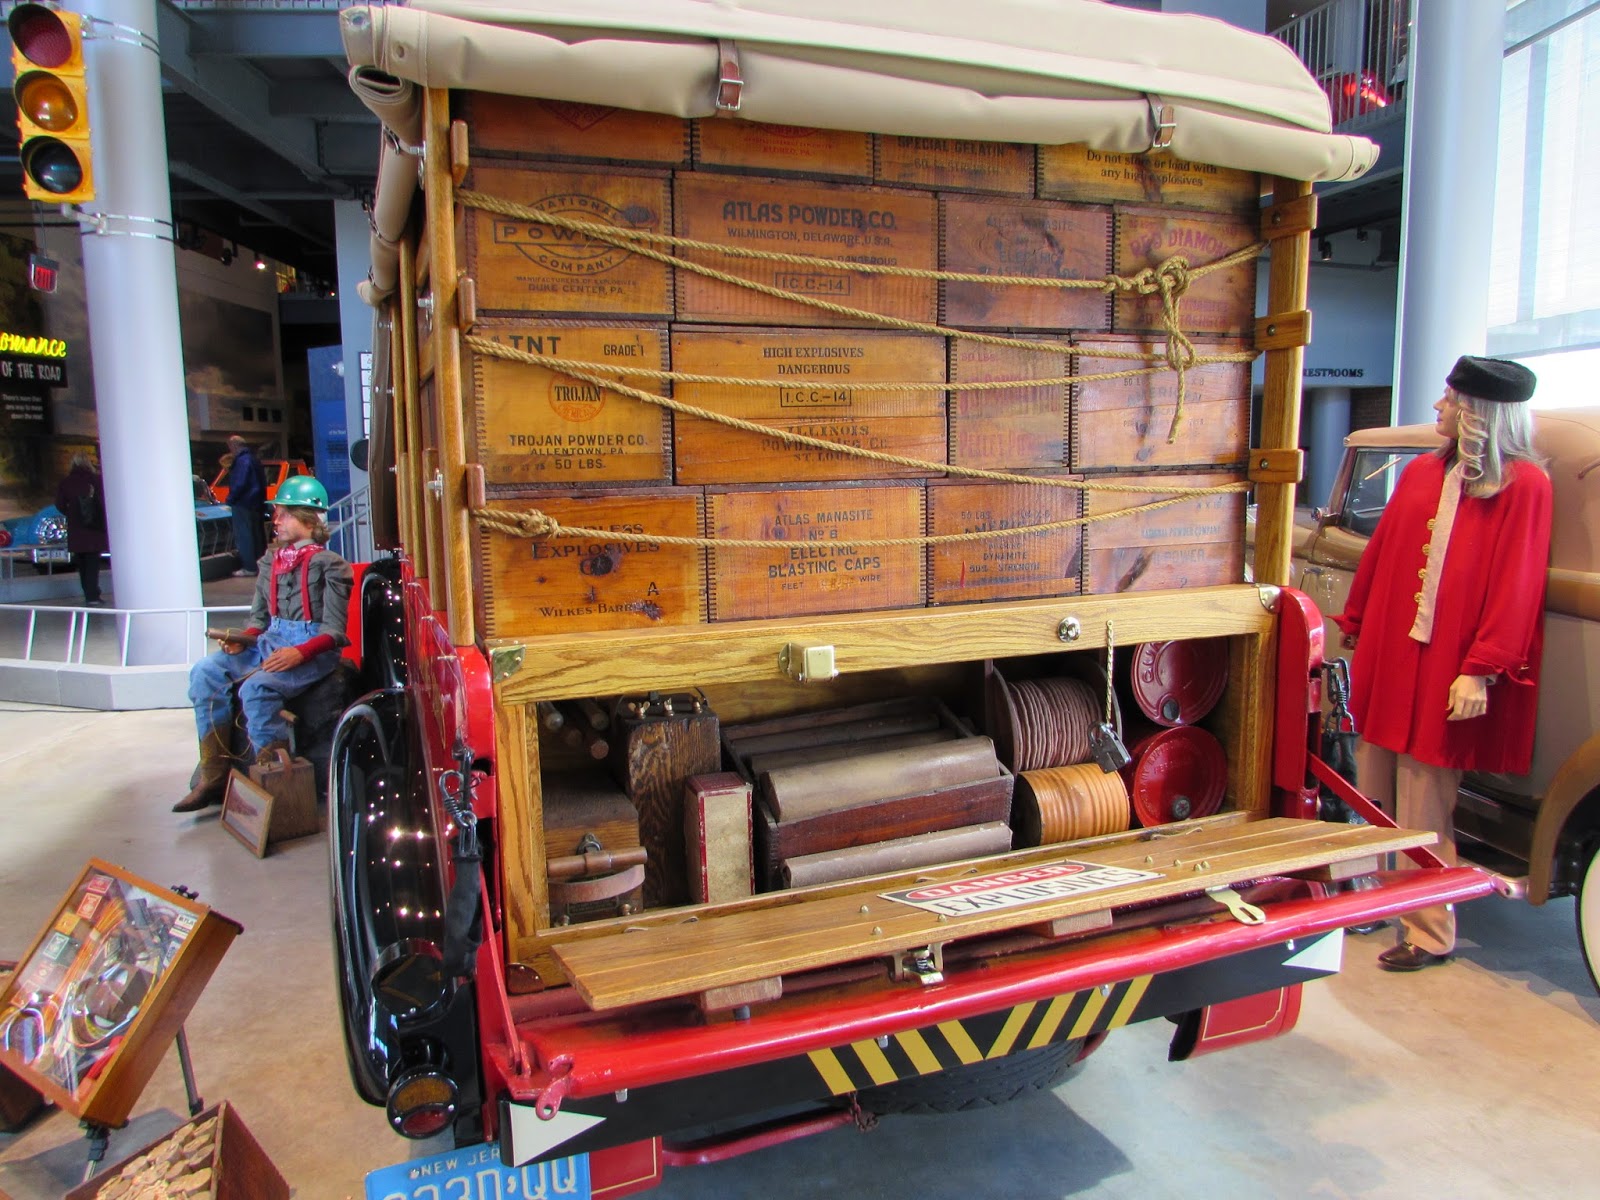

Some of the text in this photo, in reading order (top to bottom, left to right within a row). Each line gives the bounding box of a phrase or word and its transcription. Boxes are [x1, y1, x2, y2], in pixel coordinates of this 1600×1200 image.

[1087, 150, 1101, 161] Do
[1104, 153, 1121, 164] not
[1154, 160, 1166, 168] or
[1168, 160, 1190, 172] load
[1193, 163, 1217, 174] with
[1100, 168, 1121, 179] any
[723, 201, 897, 230] ATLAS POWDER CO.
[504, 226, 642, 245] POW
[727, 227, 800, 242] WILMINGTON,
[538, 254, 614, 272] COMPANY
[529, 283, 558, 292] DUKE
[0, 332, 67, 357] omance
[509, 335, 561, 355] TNT
[603, 343, 637, 357] GRADE
[763, 347, 864, 358] HIGH EXPLOSIVES
[2, 361, 61, 381] OF THE ROAD
[778, 364, 850, 375] DANGEROUS
[1303, 368, 1364, 378] RESTROOMS
[554, 385, 601, 402] TROJAN
[788, 425, 869, 436] ILLINOIS
[509, 434, 648, 446] TROJAN POWDER CO.
[610, 447, 628, 455] PA.
[555, 458, 571, 470] 50
[579, 458, 606, 470] LBS.
[775, 508, 874, 526] ATLAS MANASITE
[790, 545, 858, 561] ELECTRIC
[768, 556, 881, 578] BLASTING CAPS
[647, 581, 660, 597] A
[781, 574, 881, 591] FEET WIRE
[917, 864, 1077, 899] DANGER
[933, 868, 1146, 912] EXPLOSIVES
[421, 1148, 500, 1176] NEW JER
